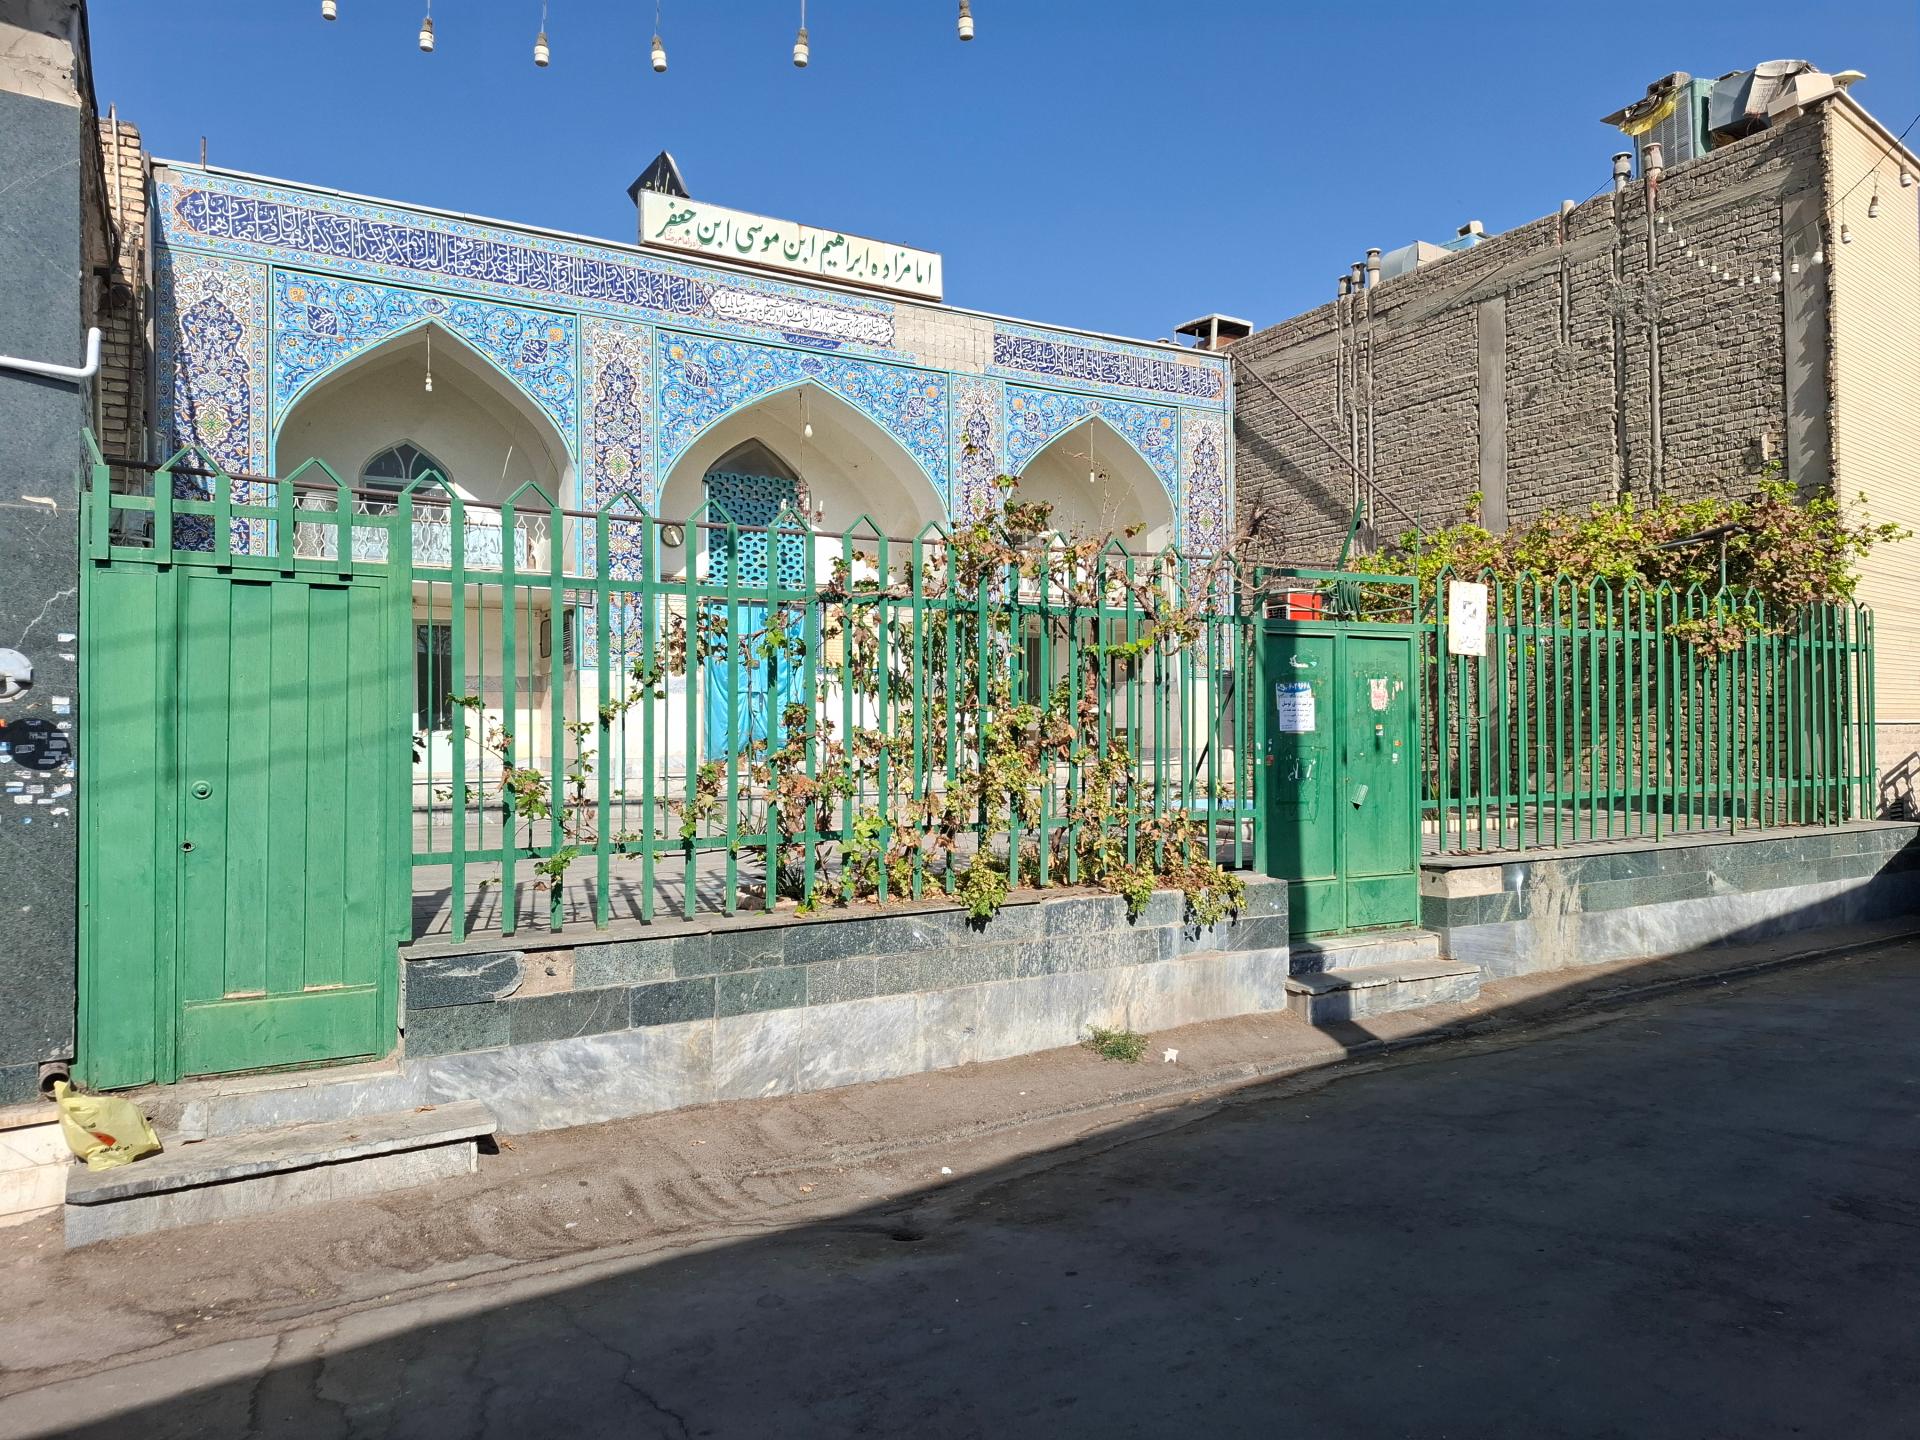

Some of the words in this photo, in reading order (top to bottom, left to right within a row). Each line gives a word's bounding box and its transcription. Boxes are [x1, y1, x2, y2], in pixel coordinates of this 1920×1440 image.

[655, 201, 697, 238] جعفر
[697, 218, 731, 249] ابن
[735, 224, 780, 253] موسی
[783, 234, 816, 262] ابن
[820, 233, 869, 278] ابراهیم
